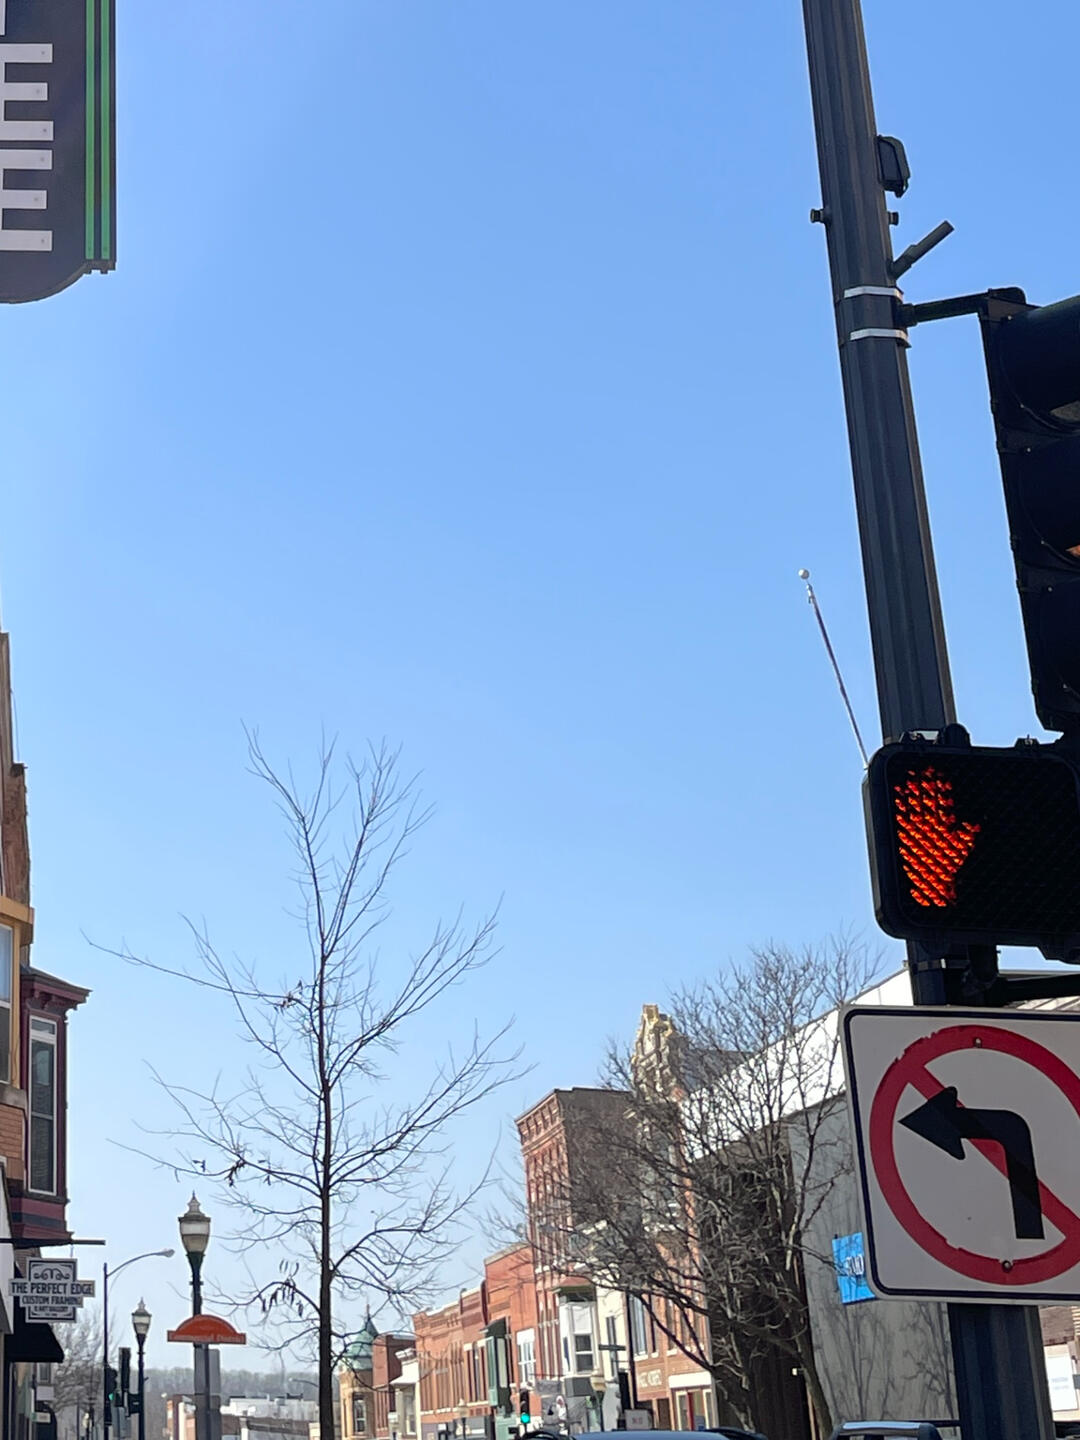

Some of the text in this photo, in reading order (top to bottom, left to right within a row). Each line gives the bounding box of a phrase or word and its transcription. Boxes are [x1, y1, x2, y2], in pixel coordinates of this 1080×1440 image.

[11, 1282, 92, 1295] THE PERFECT EDGE
[22, 1295, 49, 1305] CUSTOM
